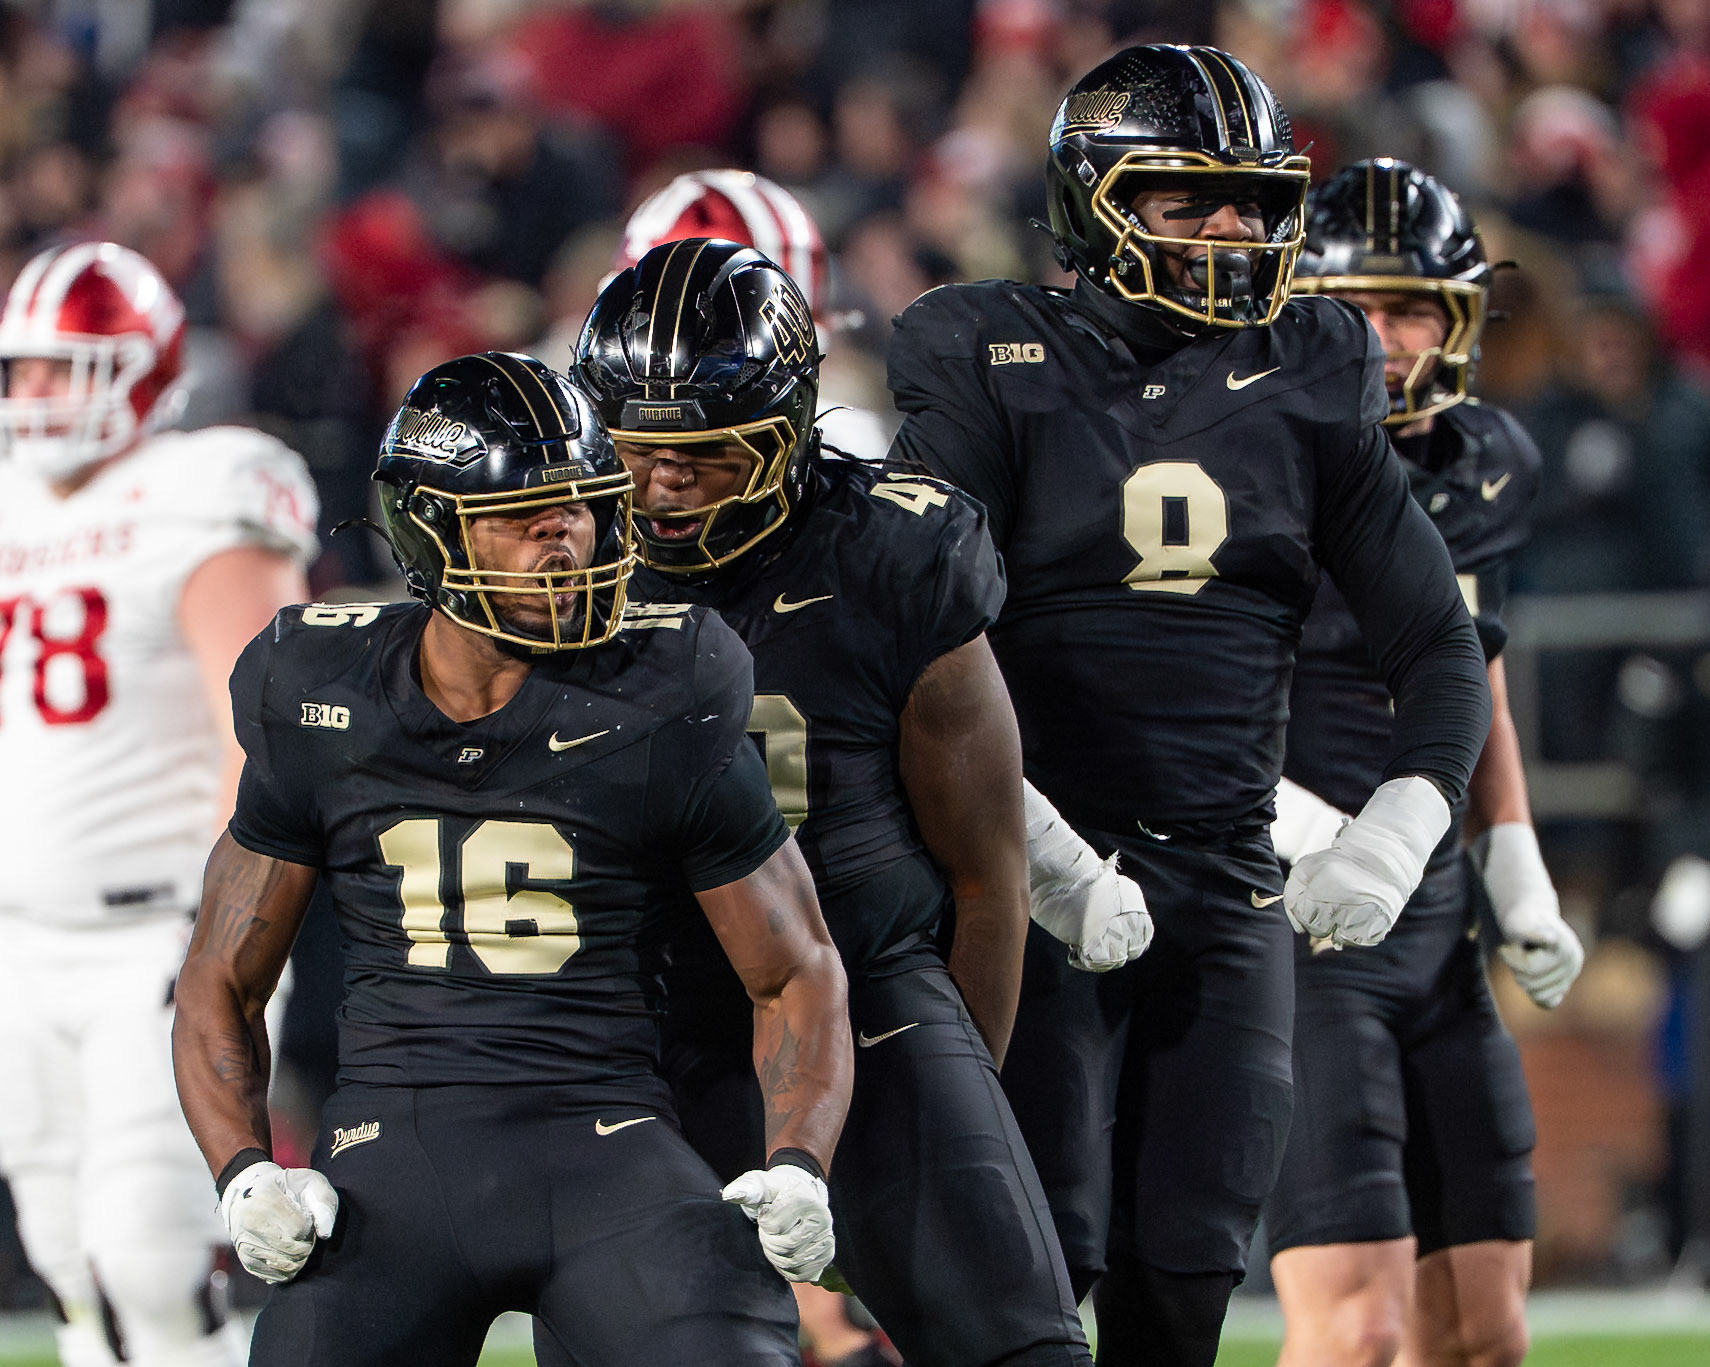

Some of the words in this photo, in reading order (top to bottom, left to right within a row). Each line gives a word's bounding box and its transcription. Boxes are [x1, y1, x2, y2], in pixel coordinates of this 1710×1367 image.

[1200, 297, 1228, 308] BLER
[758, 283, 815, 364] 40
[1142, 384, 1166, 400] P
[639, 407, 682, 421] PURDUE
[542, 465, 583, 483] PURDUE
[869, 472, 956, 517] 4
[1122, 460, 1231, 595] 8
[456, 747, 484, 764] P
[377, 818, 581, 975] 16
[331, 1121, 380, 1155] Purdue
